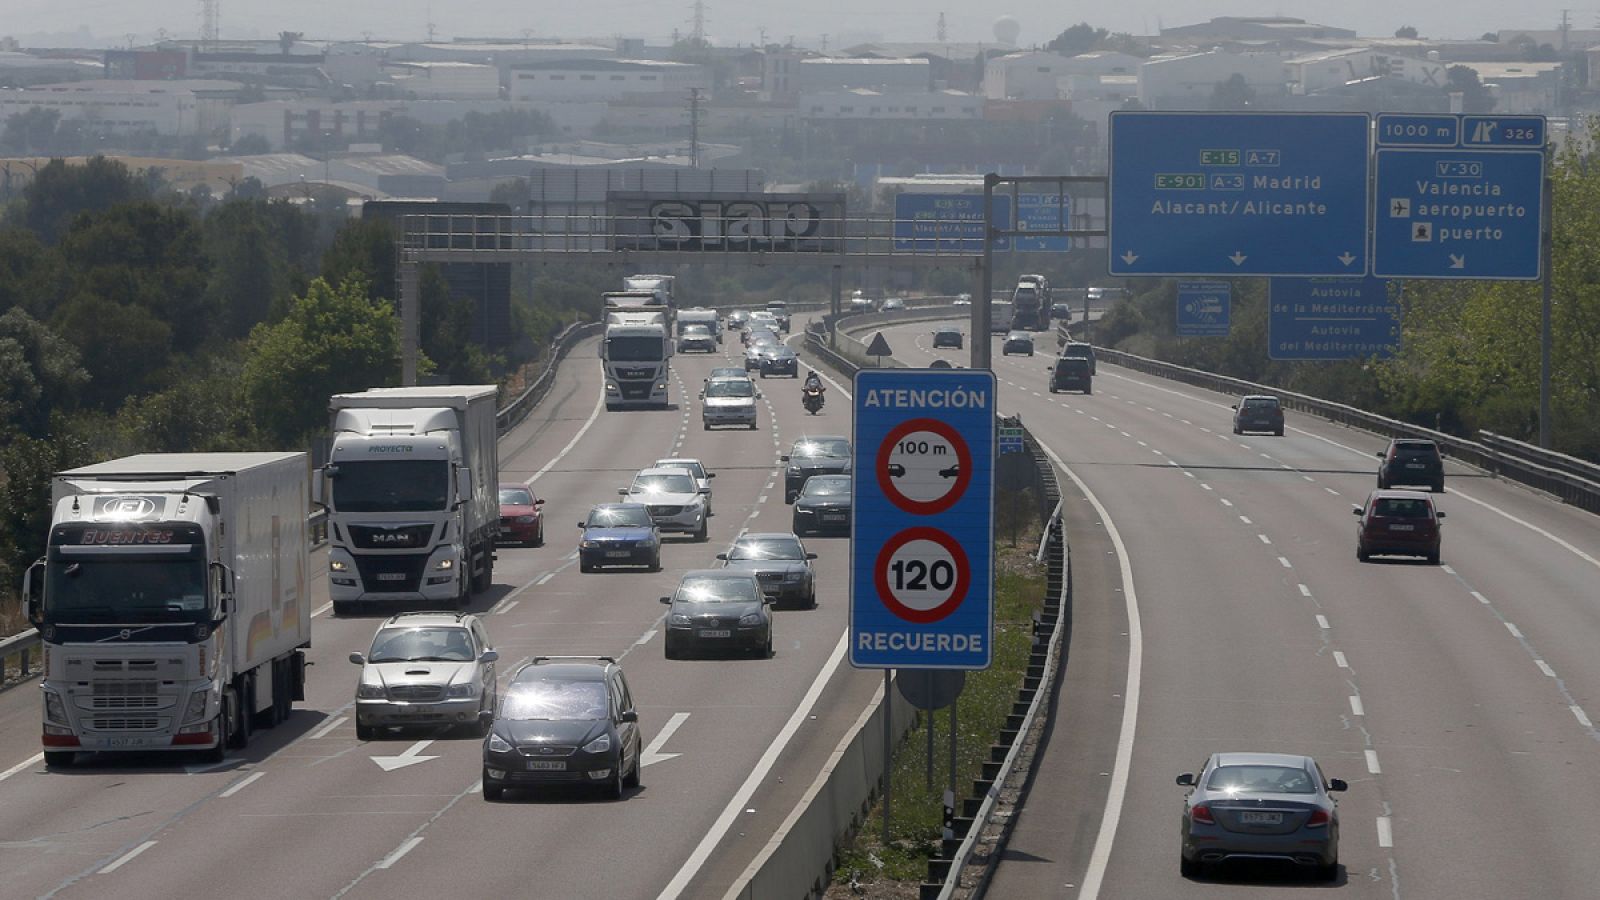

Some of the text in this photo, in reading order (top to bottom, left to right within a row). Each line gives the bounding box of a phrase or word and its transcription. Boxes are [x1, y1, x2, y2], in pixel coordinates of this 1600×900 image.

[1386, 125, 1450, 137] 1000 m
[1505, 129, 1534, 140] 326
[1202, 152, 1277, 163] E-15 A-7
[1439, 163, 1480, 175] V-30
[1157, 176, 1321, 189] E-901 A-3 Madrid
[1416, 180, 1501, 196] Valencia
[1151, 200, 1327, 215] Alacant/Alicante
[1418, 204, 1526, 219] aeropuerto
[1439, 226, 1503, 243] puerto
[1273, 303, 1288, 313] de
[1295, 303, 1306, 313] la
[1279, 341, 1298, 351] del
[864, 385, 985, 408] ATENCIÓN
[898, 441, 947, 455] 100 m
[81, 528, 173, 544] FUENTES
[372, 534, 409, 543] MAN
[891, 560, 954, 591] 120
[858, 632, 983, 652] RECUERDE
